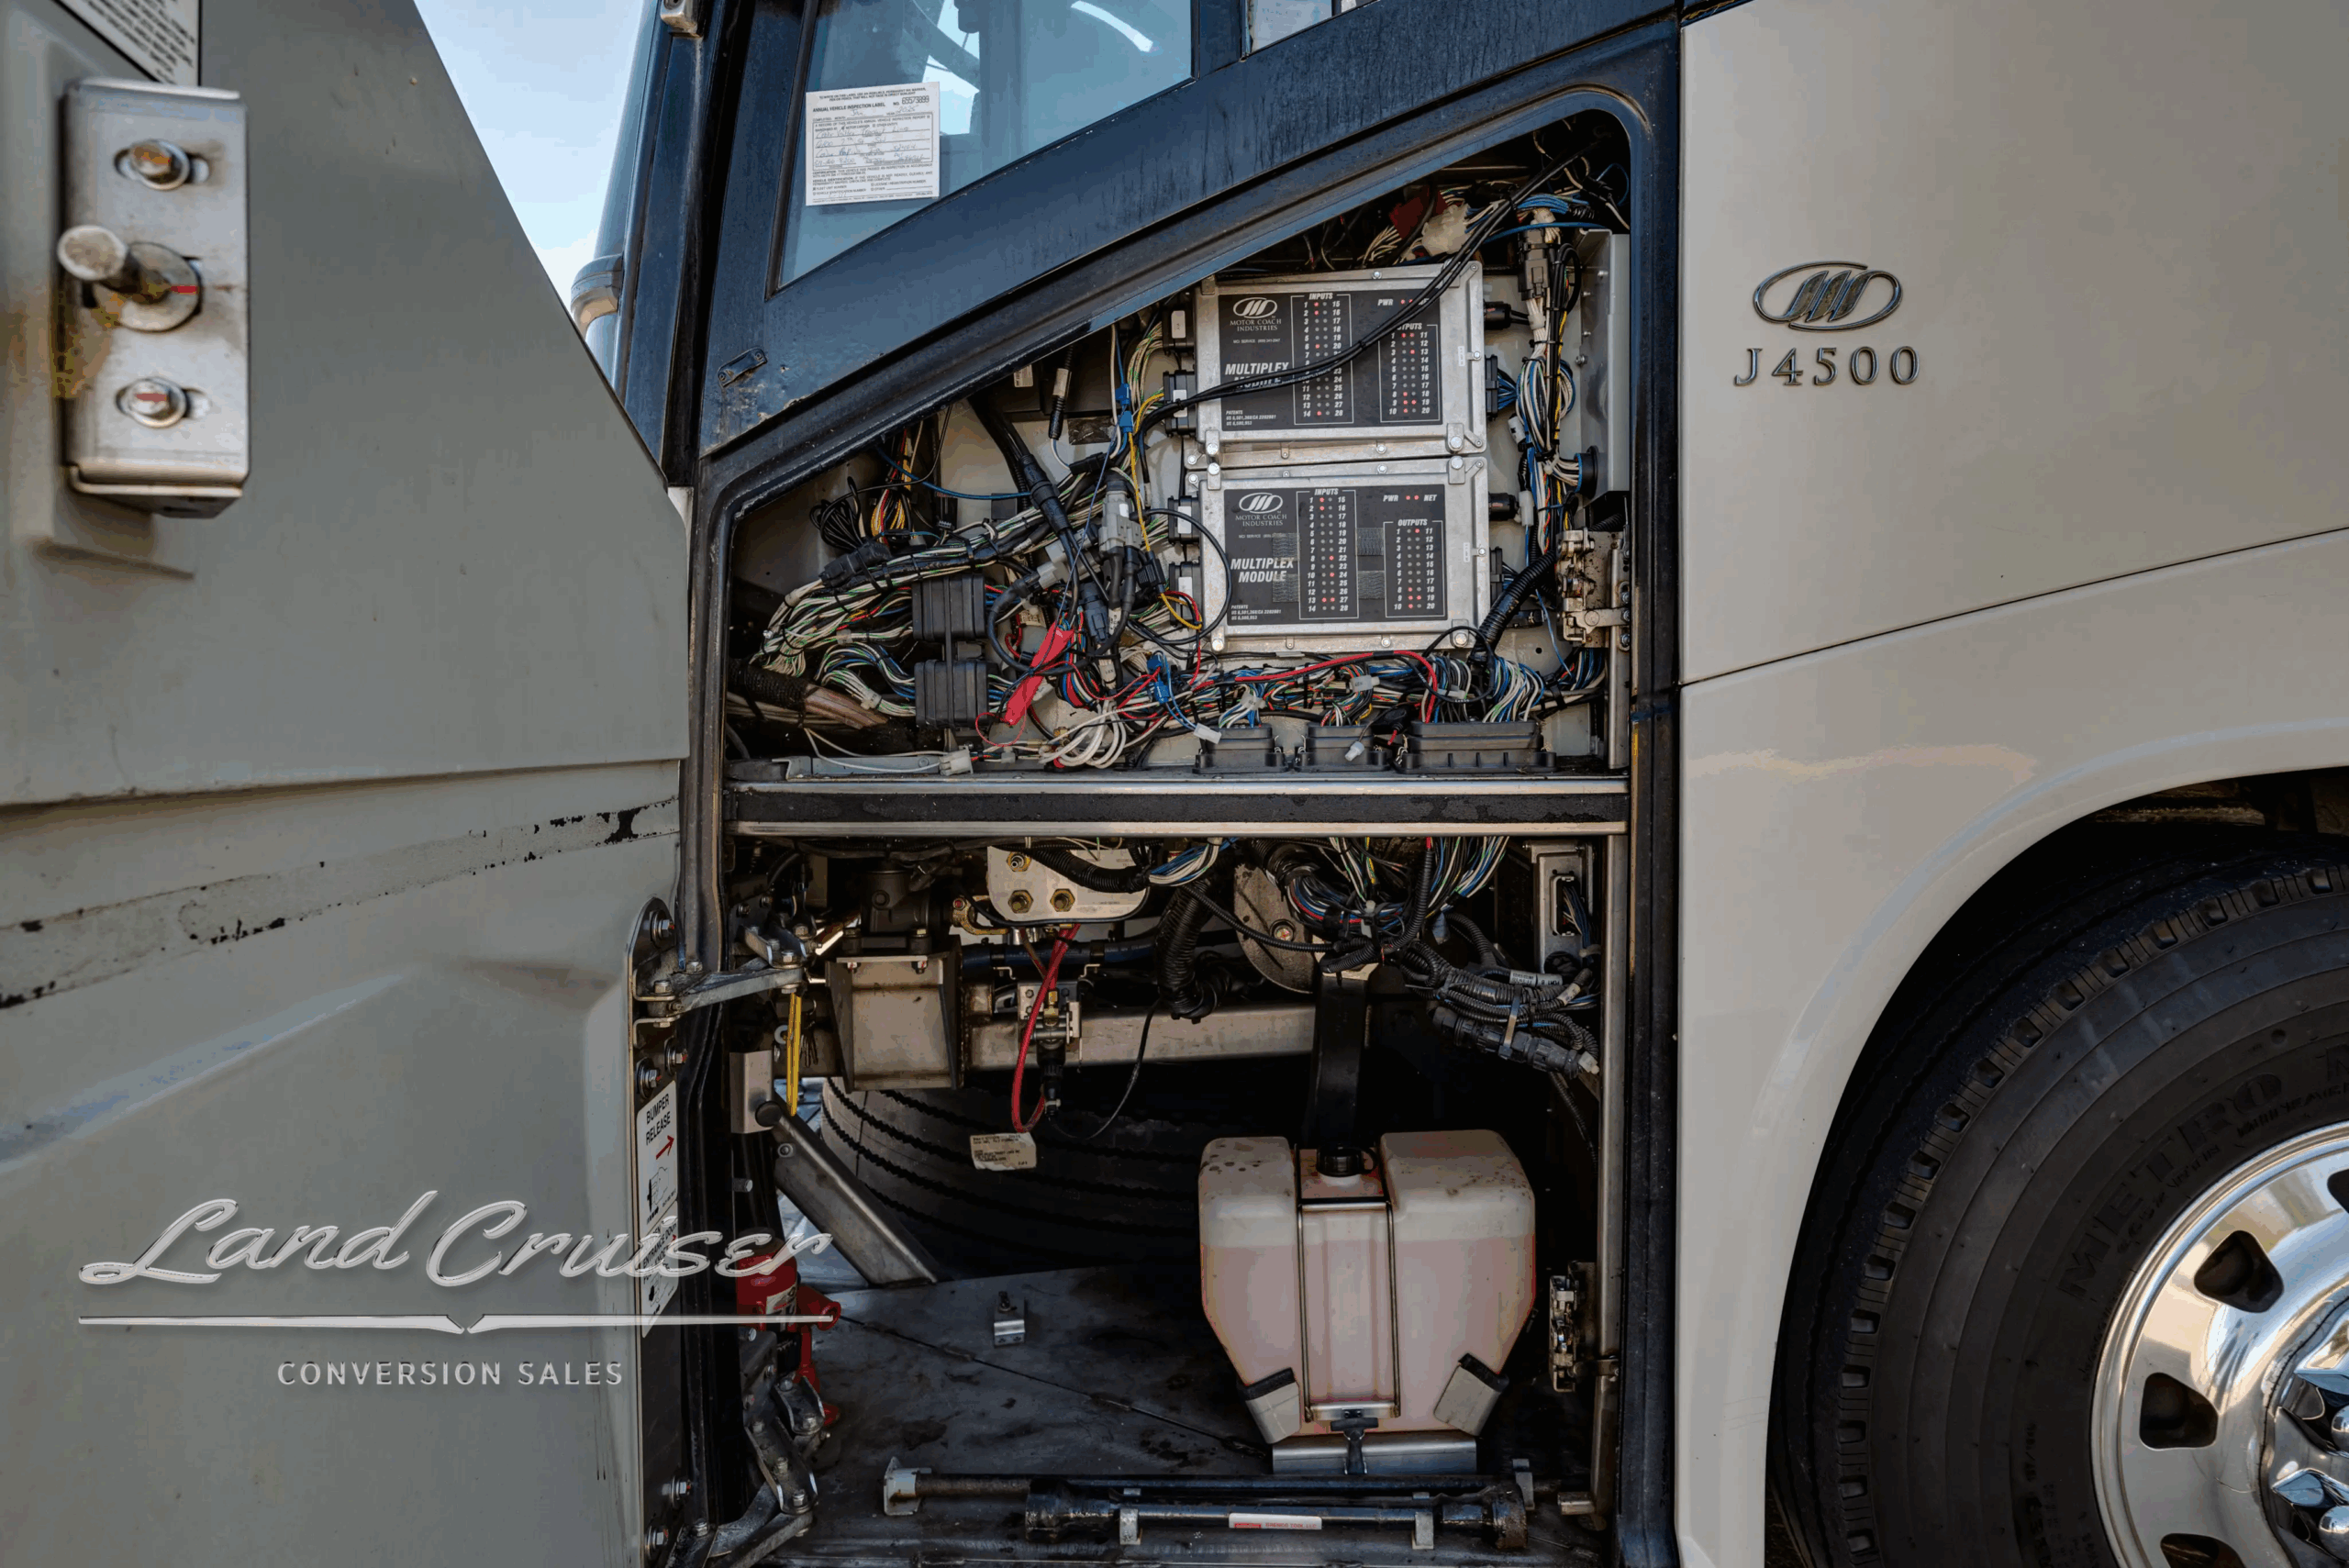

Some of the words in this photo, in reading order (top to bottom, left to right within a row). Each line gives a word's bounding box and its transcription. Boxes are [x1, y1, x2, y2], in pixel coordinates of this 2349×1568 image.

[1225, 362, 1289, 375] MULTIPLEX
[1733, 346, 1920, 386] J4500
[1230, 557, 1294, 570] MULTIPLEX
[1238, 571, 1287, 583] MODULE
[646, 1093, 669, 1125] BUMPER
[646, 1111, 671, 1146] RELEASE
